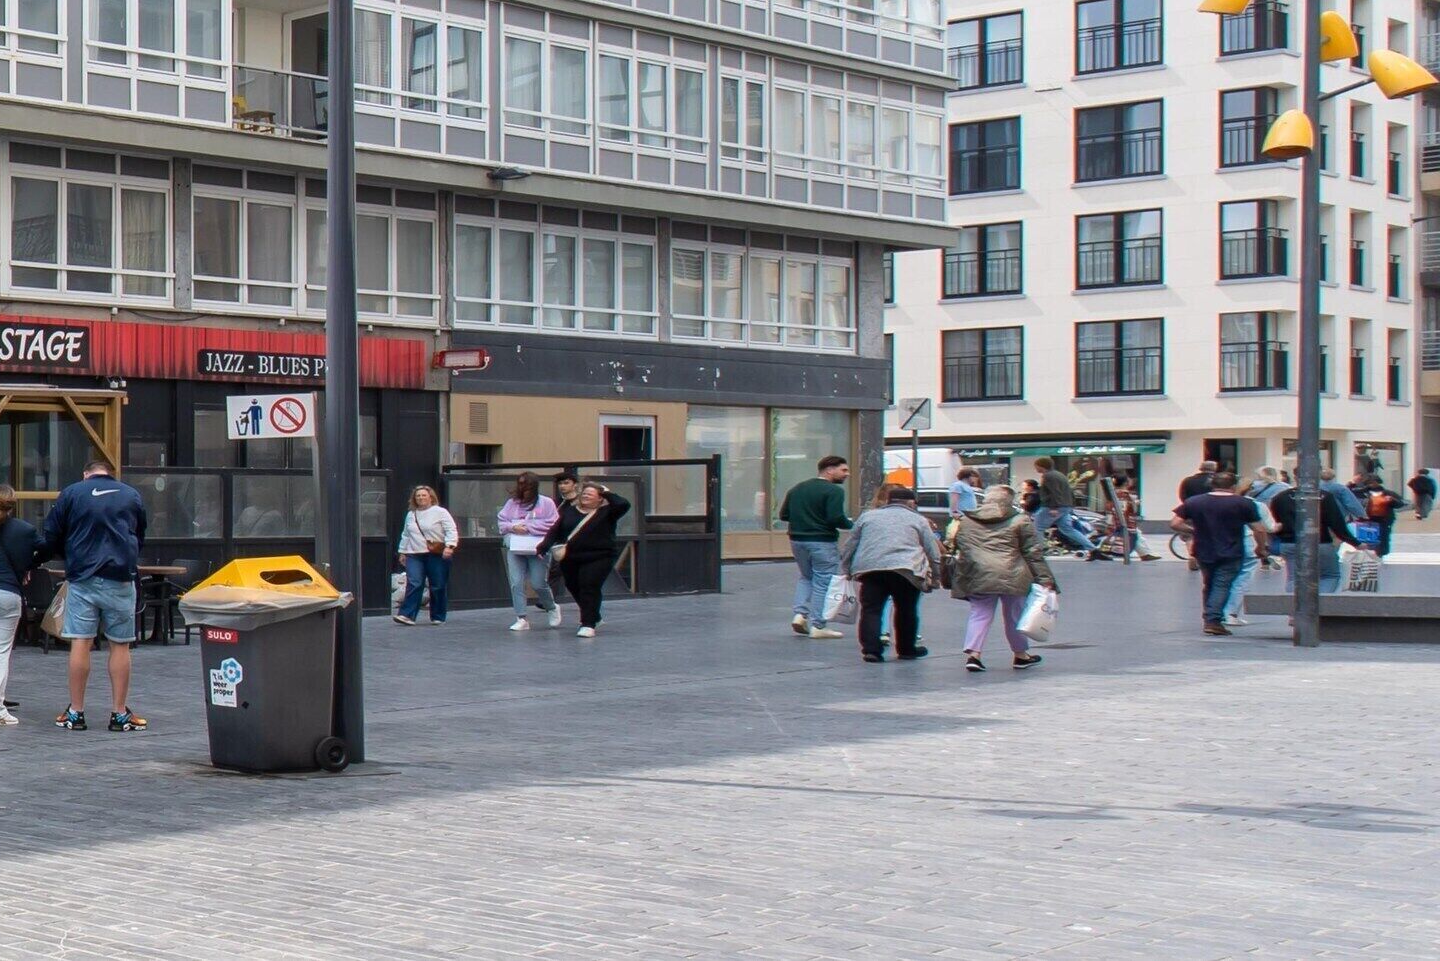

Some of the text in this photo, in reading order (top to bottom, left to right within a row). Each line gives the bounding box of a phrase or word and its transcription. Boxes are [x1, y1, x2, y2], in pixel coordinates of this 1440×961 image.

[206, 352, 245, 373] JAZZ
[258, 355, 310, 377] BLUES
[313, 358, 328, 377] P
[207, 630, 232, 640] SULO
[213, 688, 234, 697] proper
